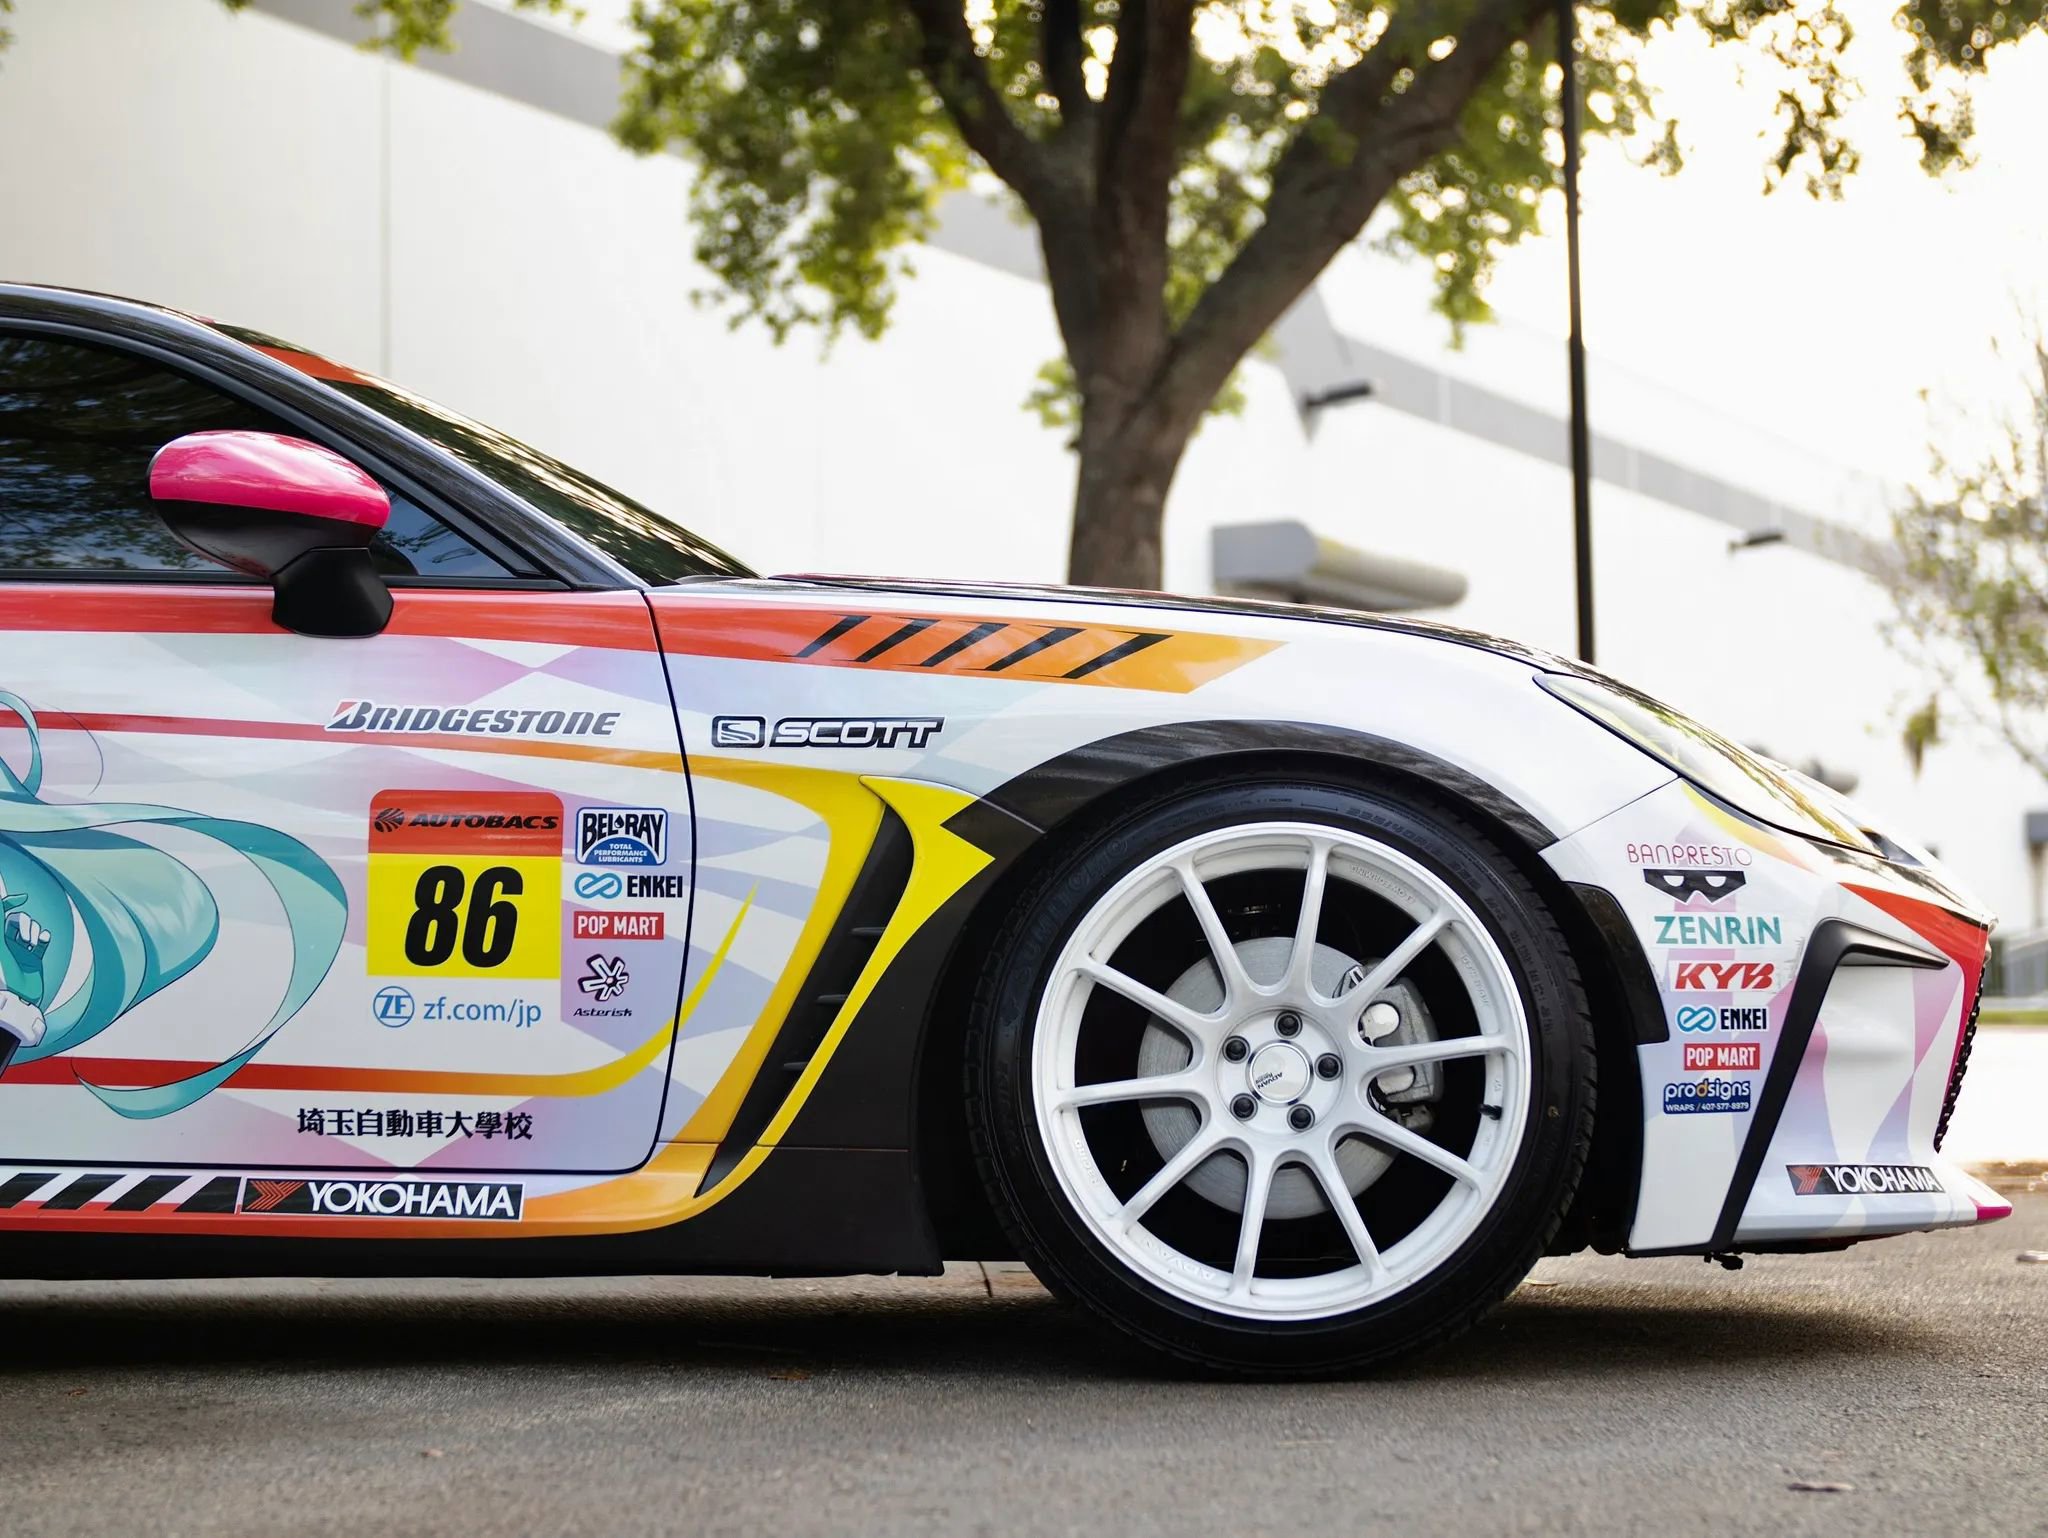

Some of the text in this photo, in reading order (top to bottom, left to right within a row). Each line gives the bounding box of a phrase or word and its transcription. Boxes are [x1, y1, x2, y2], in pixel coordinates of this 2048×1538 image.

[327, 702, 621, 735] BRIDGESTONE
[772, 719, 941, 747] SCOTT
[408, 813, 559, 830] AUTOBACS
[1627, 843, 1752, 867] BANPRESTO
[627, 875, 683, 898] ENKEI
[405, 865, 523, 968] 86
[577, 915, 659, 936] POP MART
[1654, 916, 1782, 945] ZENRIN
[1675, 963, 1775, 989] KYB
[423, 996, 541, 1028] zf.com/jp
[573, 1008, 632, 1017] Asterisk
[1720, 1008, 1767, 1030] ENKEI
[1686, 1047, 1756, 1067] POP MART
[1257, 1072, 1283, 1089] ADVAN
[1665, 1079, 1750, 1102] prodsigns
[1666, 1104, 1695, 1112] WRAPS
[297, 1108, 534, 1141] 埼玉自動車大學校
[1825, 1166, 1942, 1193] YOKOHAMA
[308, 1181, 515, 1217] YOKOHAMA
